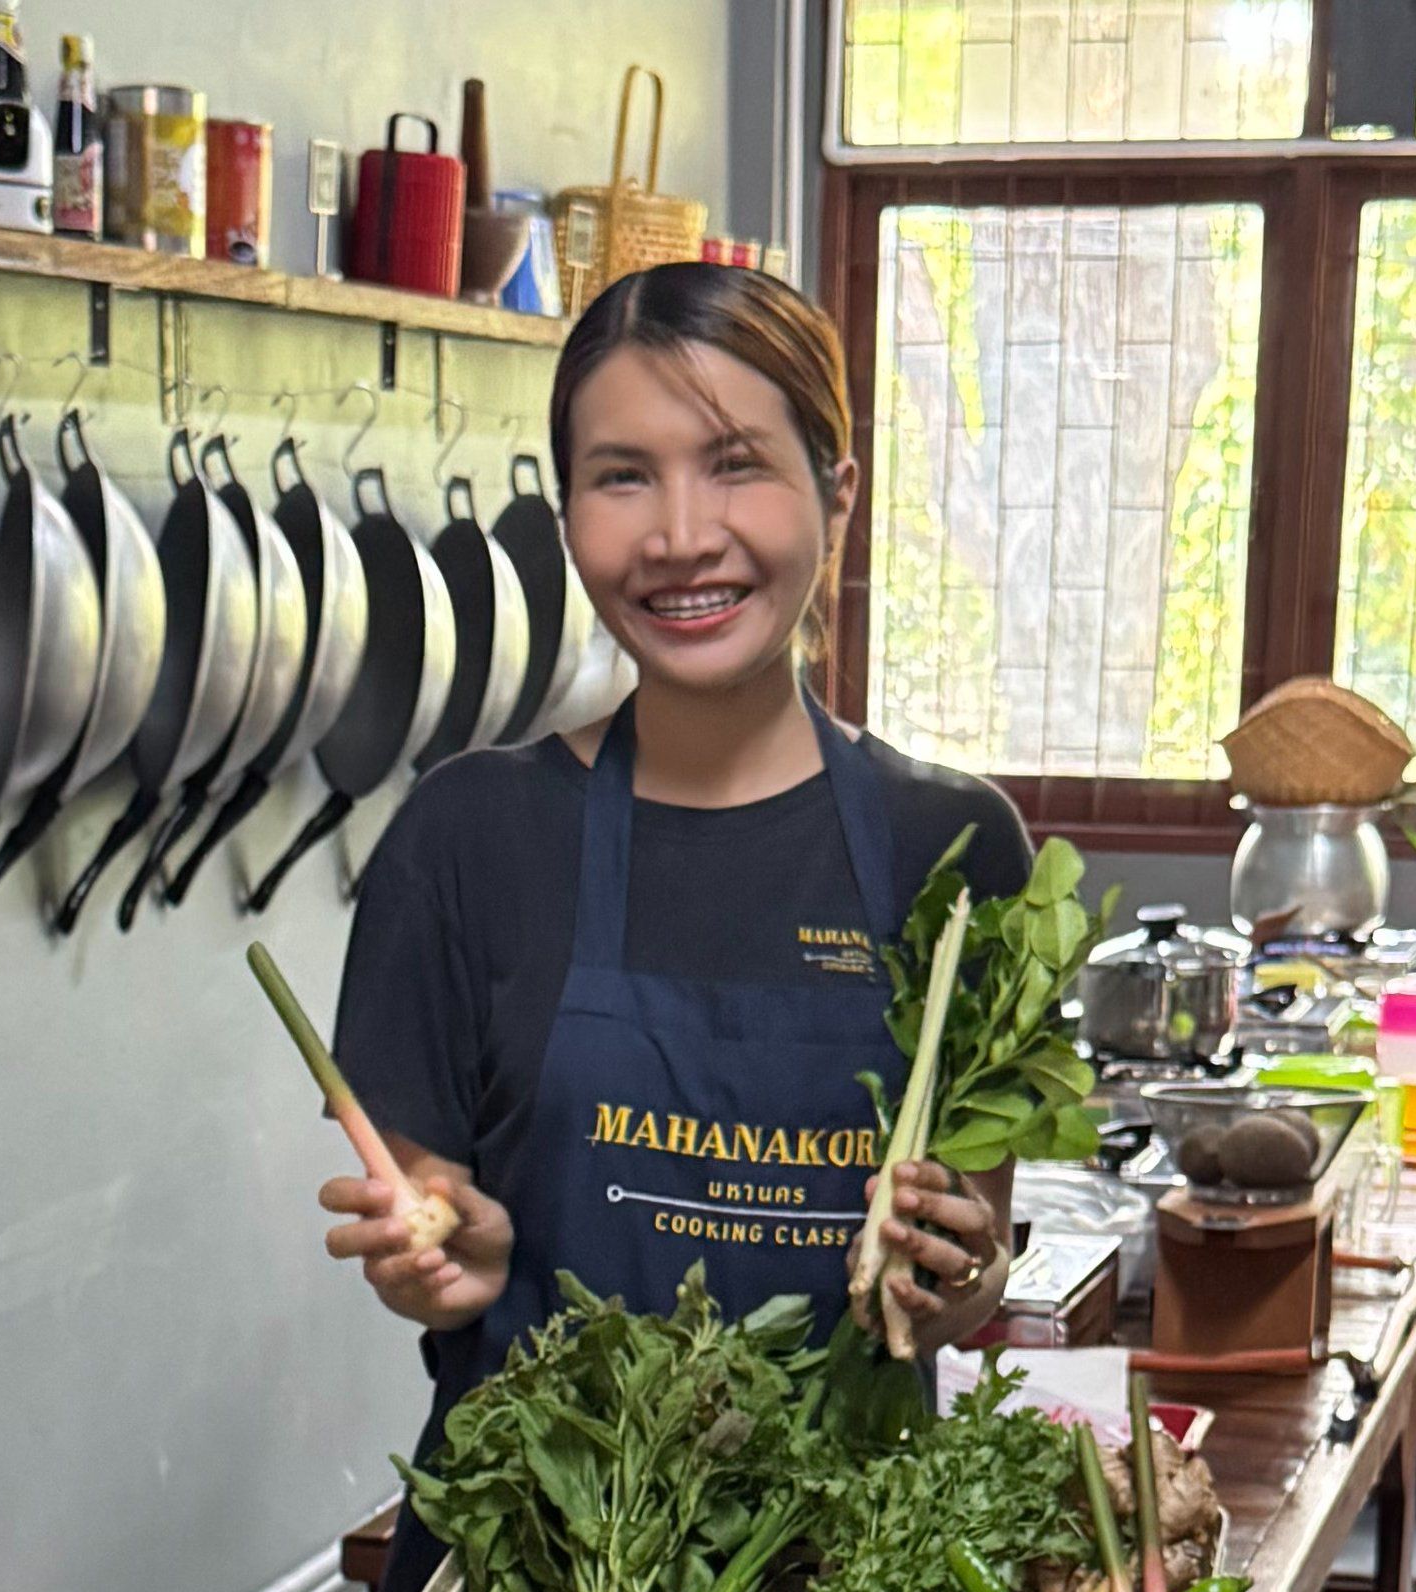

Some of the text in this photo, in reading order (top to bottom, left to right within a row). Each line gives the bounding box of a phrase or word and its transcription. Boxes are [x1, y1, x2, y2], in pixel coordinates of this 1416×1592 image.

[593, 1103, 881, 1168] MAHANAKOR
[654, 1212, 847, 1246] COOKING CLASS
